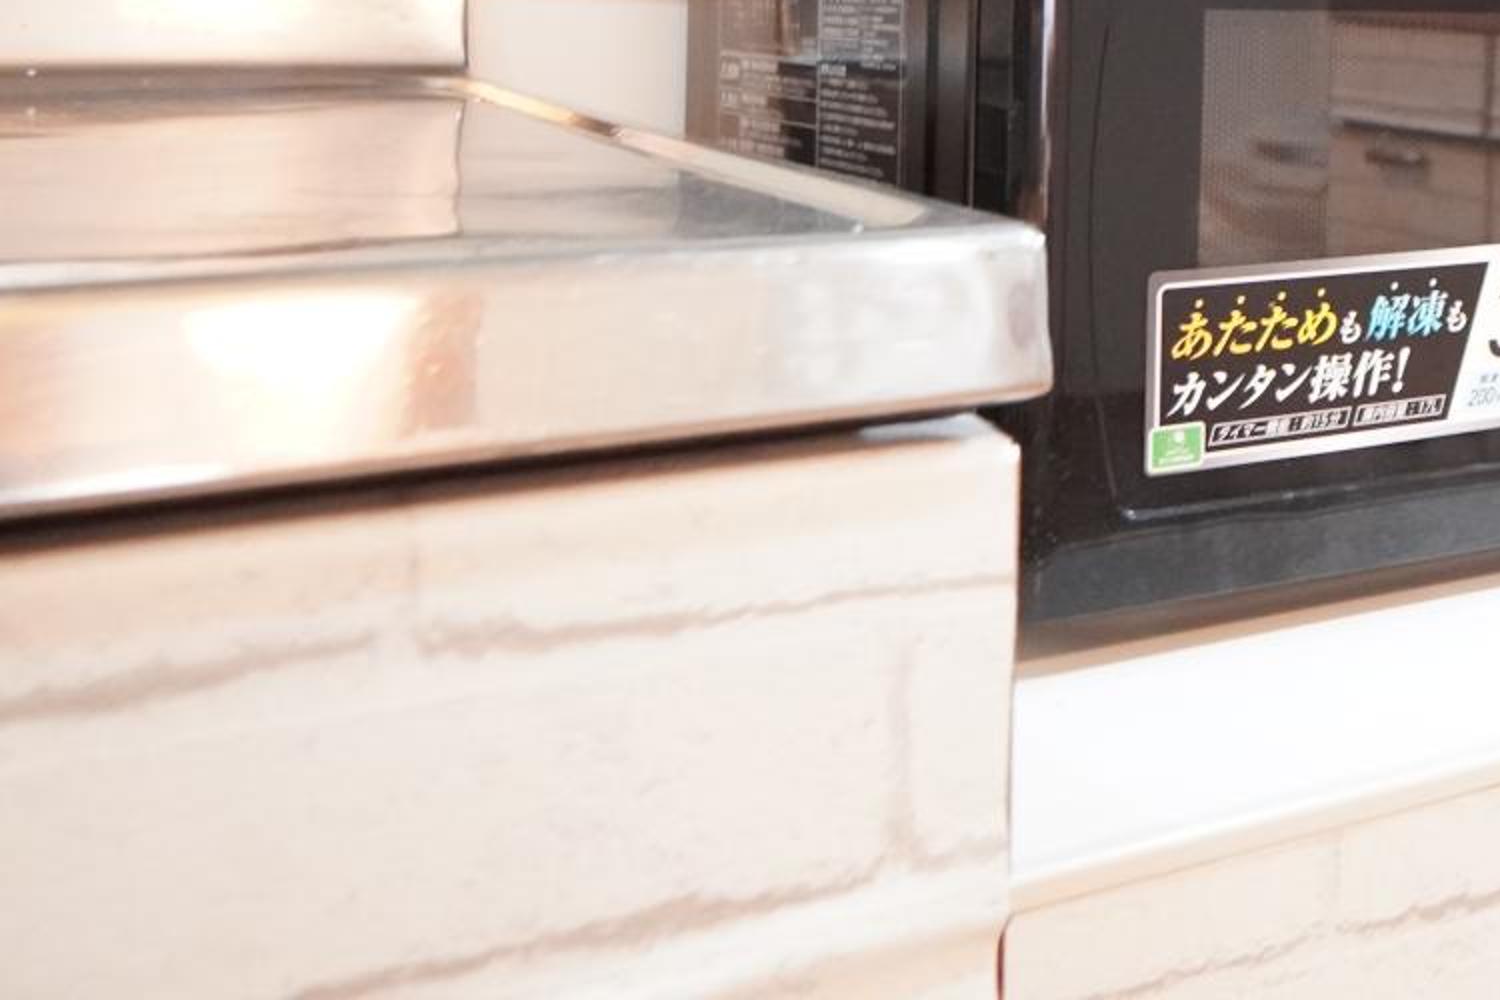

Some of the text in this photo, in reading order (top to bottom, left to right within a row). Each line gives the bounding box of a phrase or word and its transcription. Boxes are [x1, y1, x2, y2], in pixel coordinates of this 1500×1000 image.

[1169, 287, 1467, 361] あたためも解凍も
[1166, 346, 1412, 418] カンタン操作!
